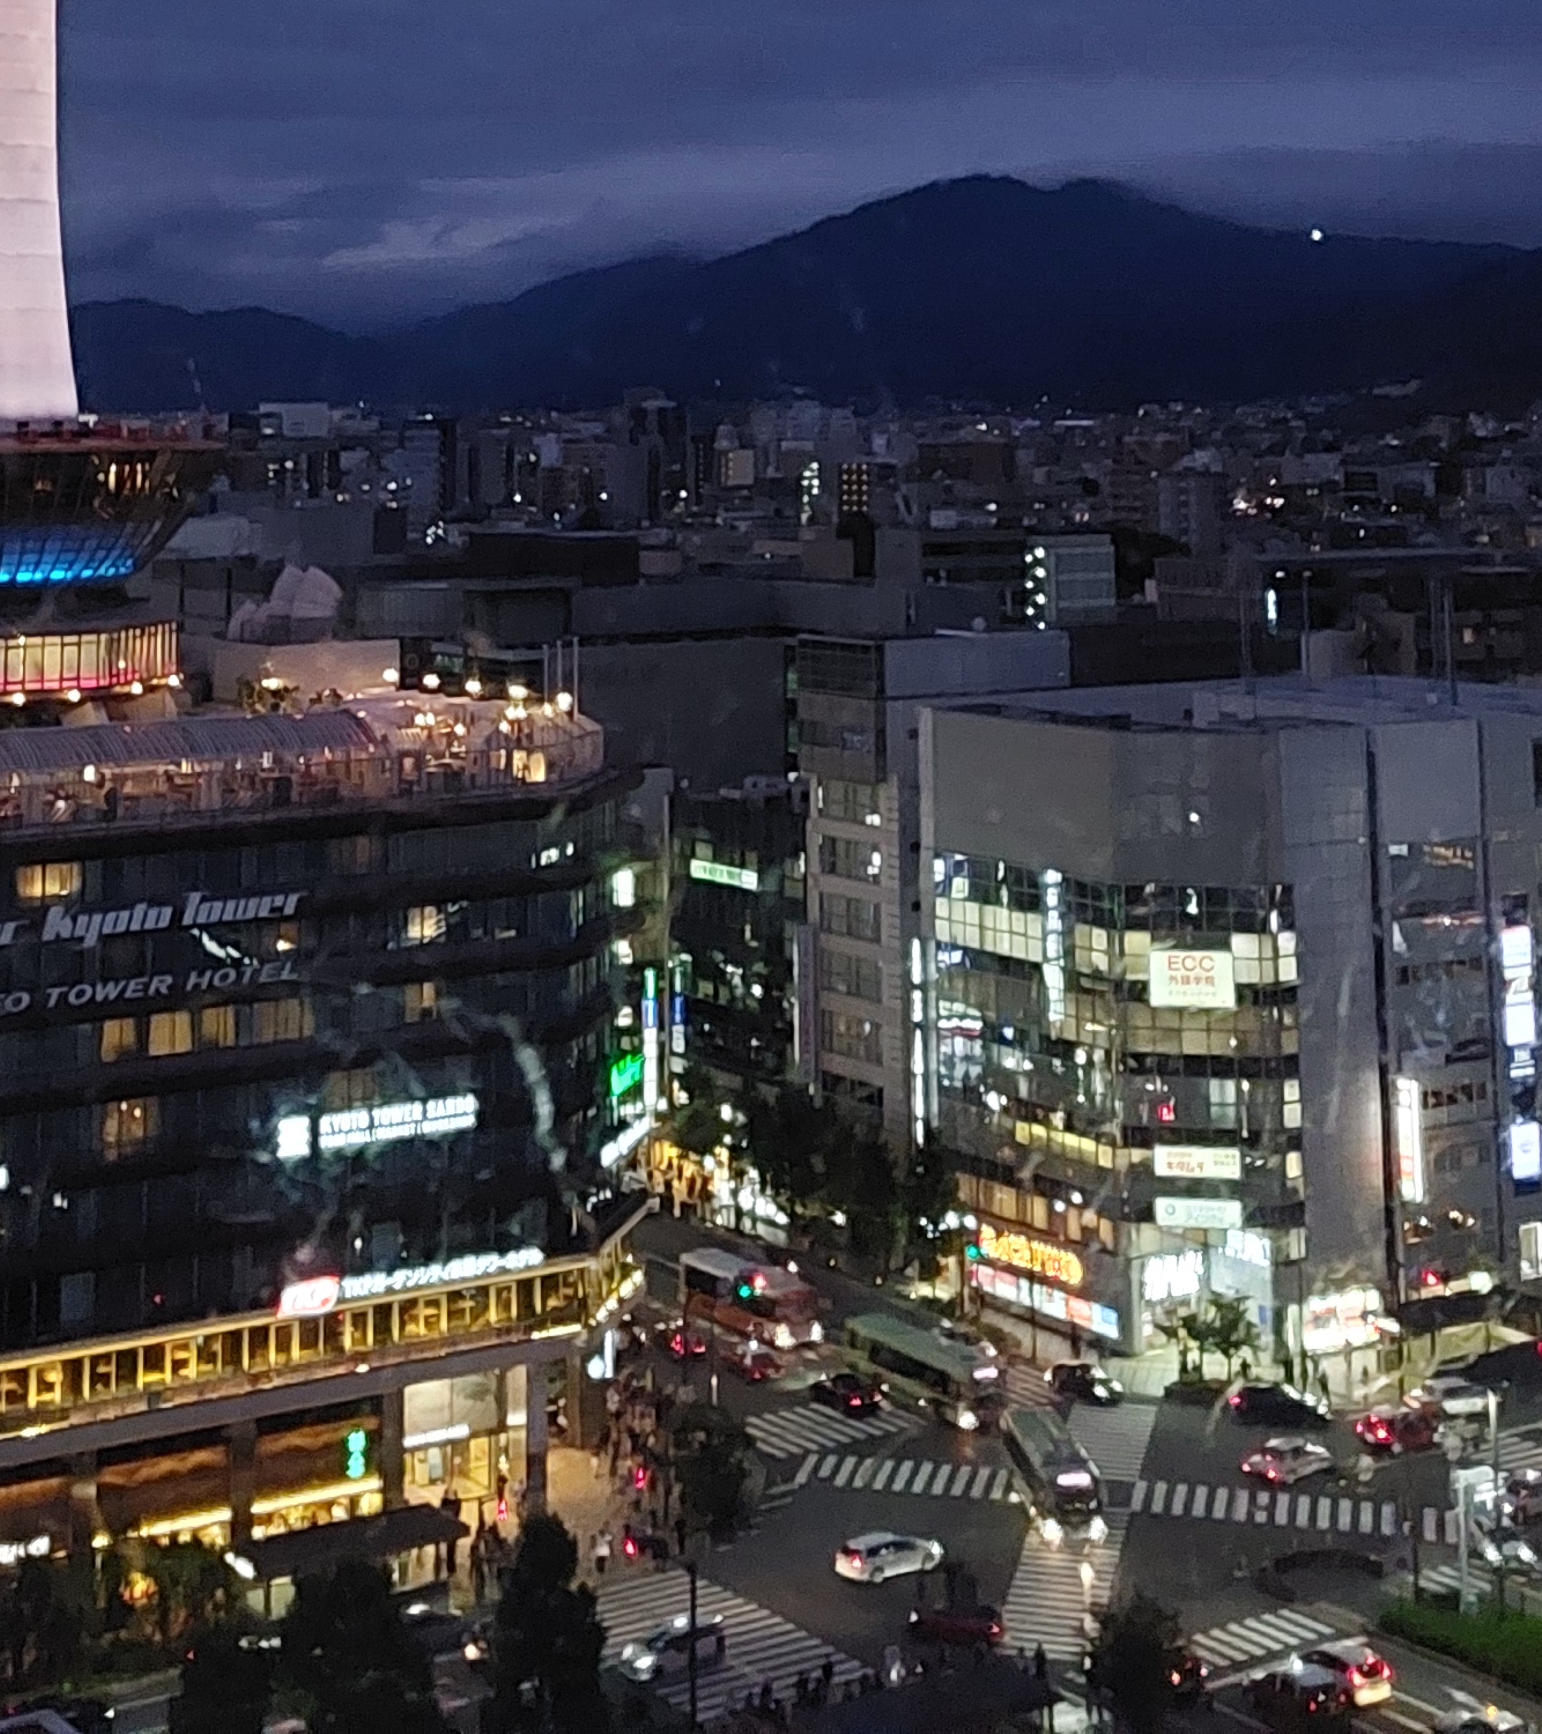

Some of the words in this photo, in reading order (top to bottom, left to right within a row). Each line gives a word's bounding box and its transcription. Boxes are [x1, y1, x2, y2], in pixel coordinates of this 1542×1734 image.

[42, 904, 173, 948] Kyoto
[181, 891, 309, 926] Tower
[45, 973, 173, 1009] TOWER
[185, 960, 303, 993] HOTEL
[1167, 954, 1216, 972] ECC
[319, 1107, 371, 1135] KYOTO
[372, 1100, 423, 1127] TOWER
[426, 1093, 479, 1119] SANDO
